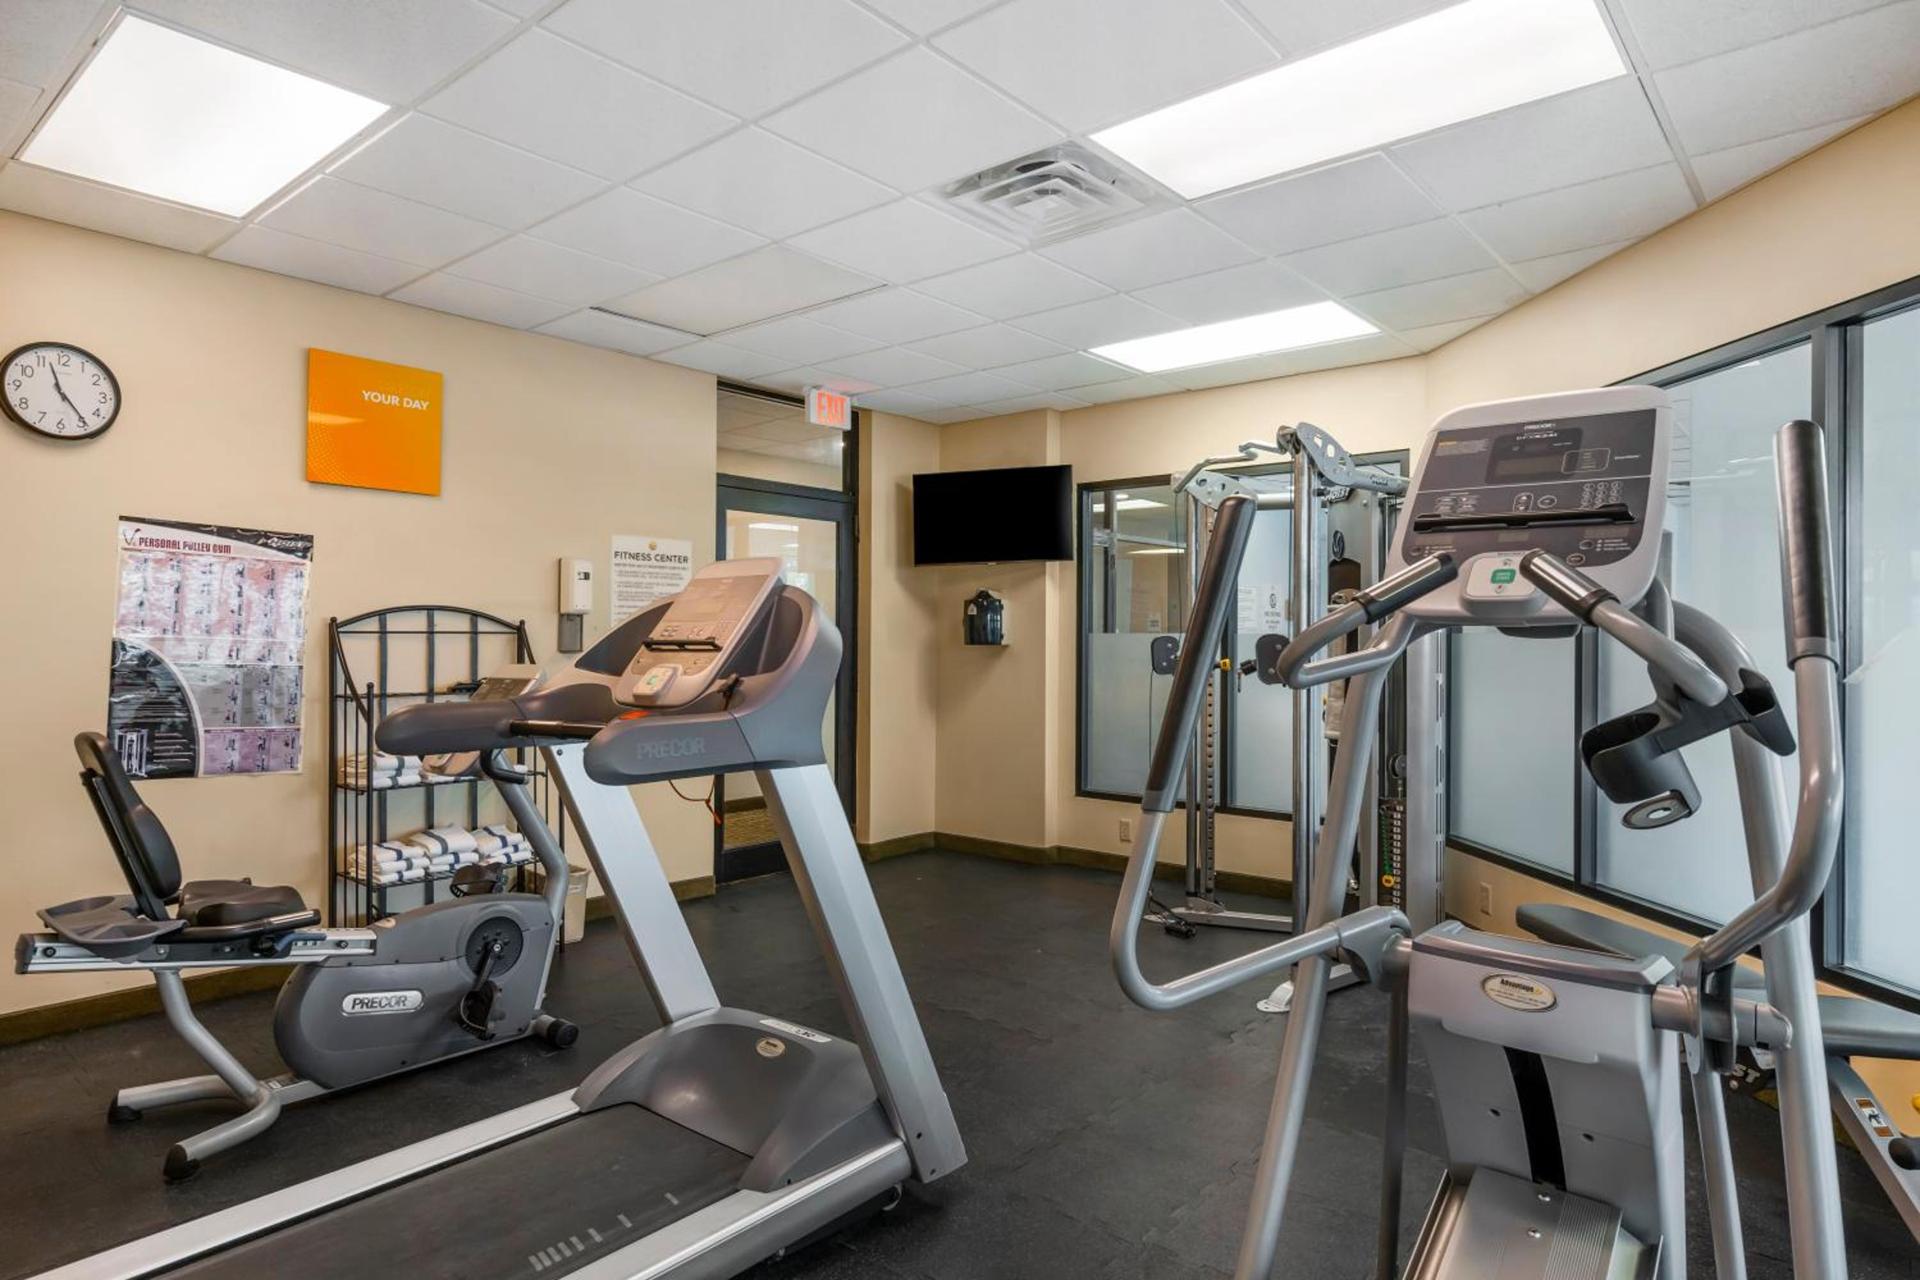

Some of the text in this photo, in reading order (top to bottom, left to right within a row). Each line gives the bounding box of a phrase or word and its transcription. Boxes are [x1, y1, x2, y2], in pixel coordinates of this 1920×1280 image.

[36, 354, 47, 368] 11
[57, 353, 71, 368] 12
[81, 361, 86, 374] 1
[20, 364, 35, 379] 10
[12, 379, 23, 392] 9
[91, 373, 102, 387] 2
[18, 396, 29, 410] 8
[98, 391, 108, 404] 3
[361, 390, 430, 411] YOUR DAY
[38, 410, 48, 424] 7
[92, 407, 102, 419] 4
[56, 418, 66, 431] 6
[76, 415, 88, 429] 5
[138, 536, 180, 550] PERSONAL
[614, 551, 689, 564] FITNESS CENTER
[636, 737, 706, 760] PRECOR
[351, 995, 408, 1010] PRECOR
